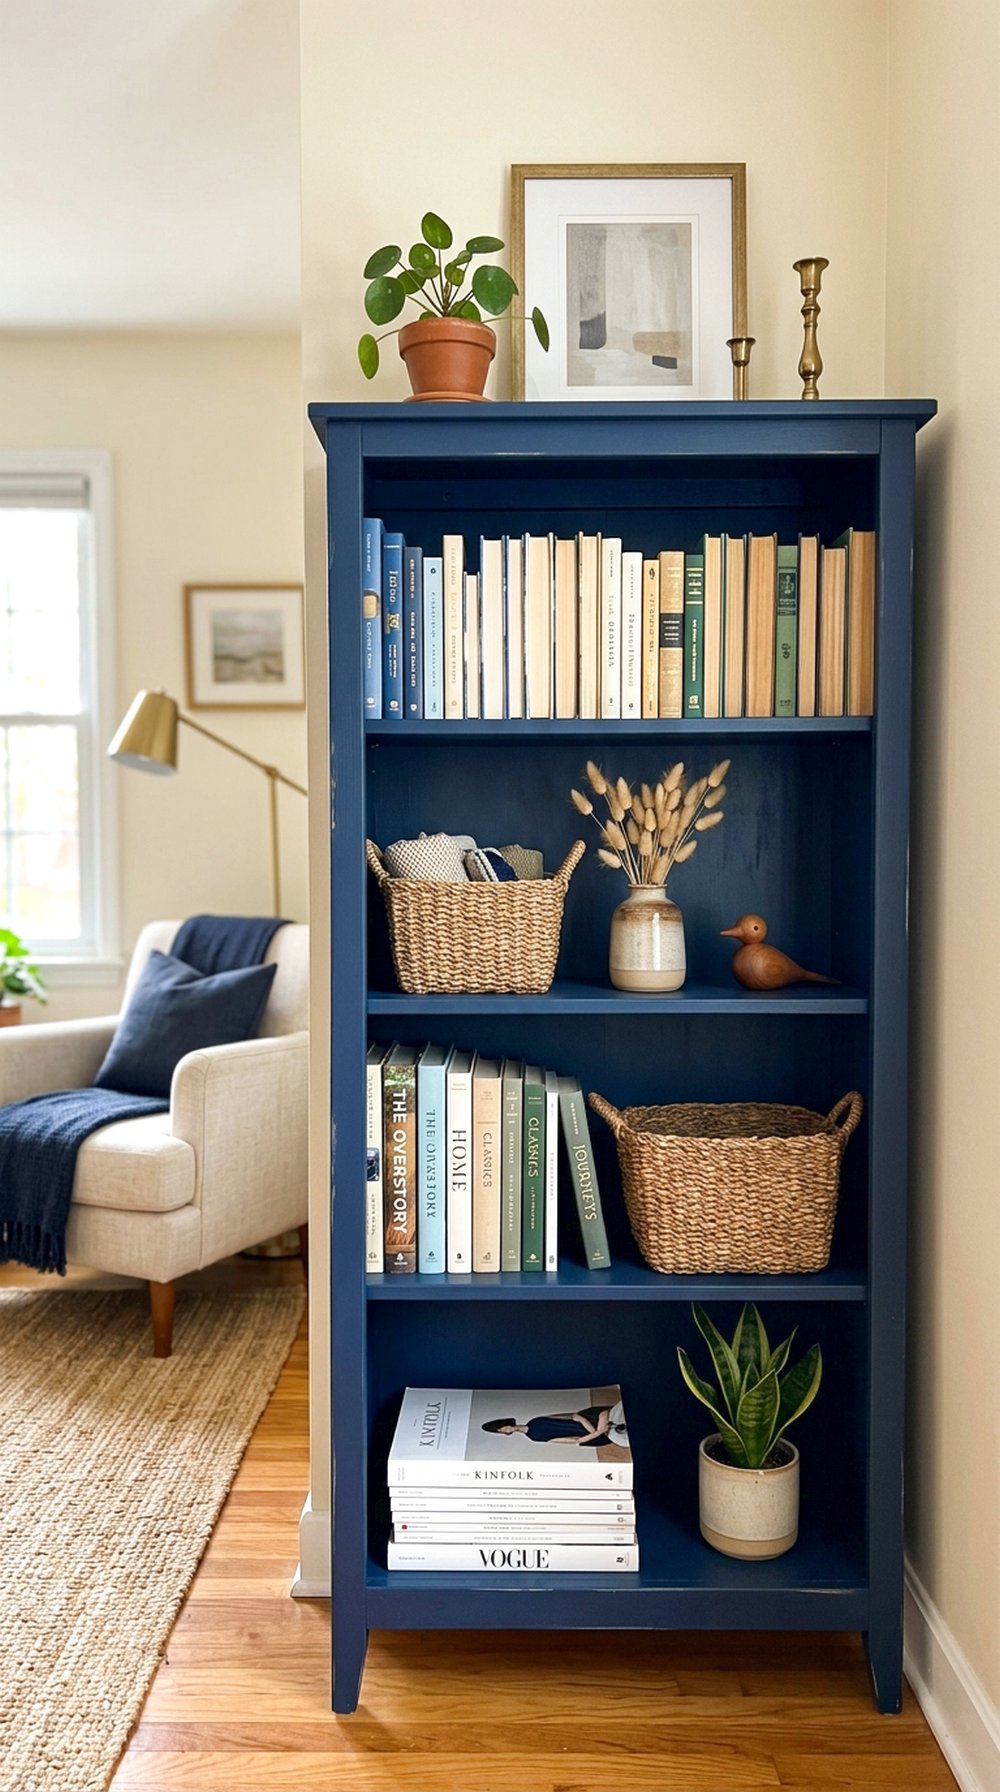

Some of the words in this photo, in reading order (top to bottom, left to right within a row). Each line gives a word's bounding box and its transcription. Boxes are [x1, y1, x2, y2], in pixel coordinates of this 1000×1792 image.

[393, 1091, 407, 1123] THE
[426, 1109, 436, 1138] THE
[452, 1130, 467, 1192] HOME
[393, 1130, 408, 1233] OVERSTORY
[572, 1144, 597, 1222] JOURNEYS
[474, 1471, 534, 1481] KINFOLK
[479, 1549, 550, 1569] VOGUE
